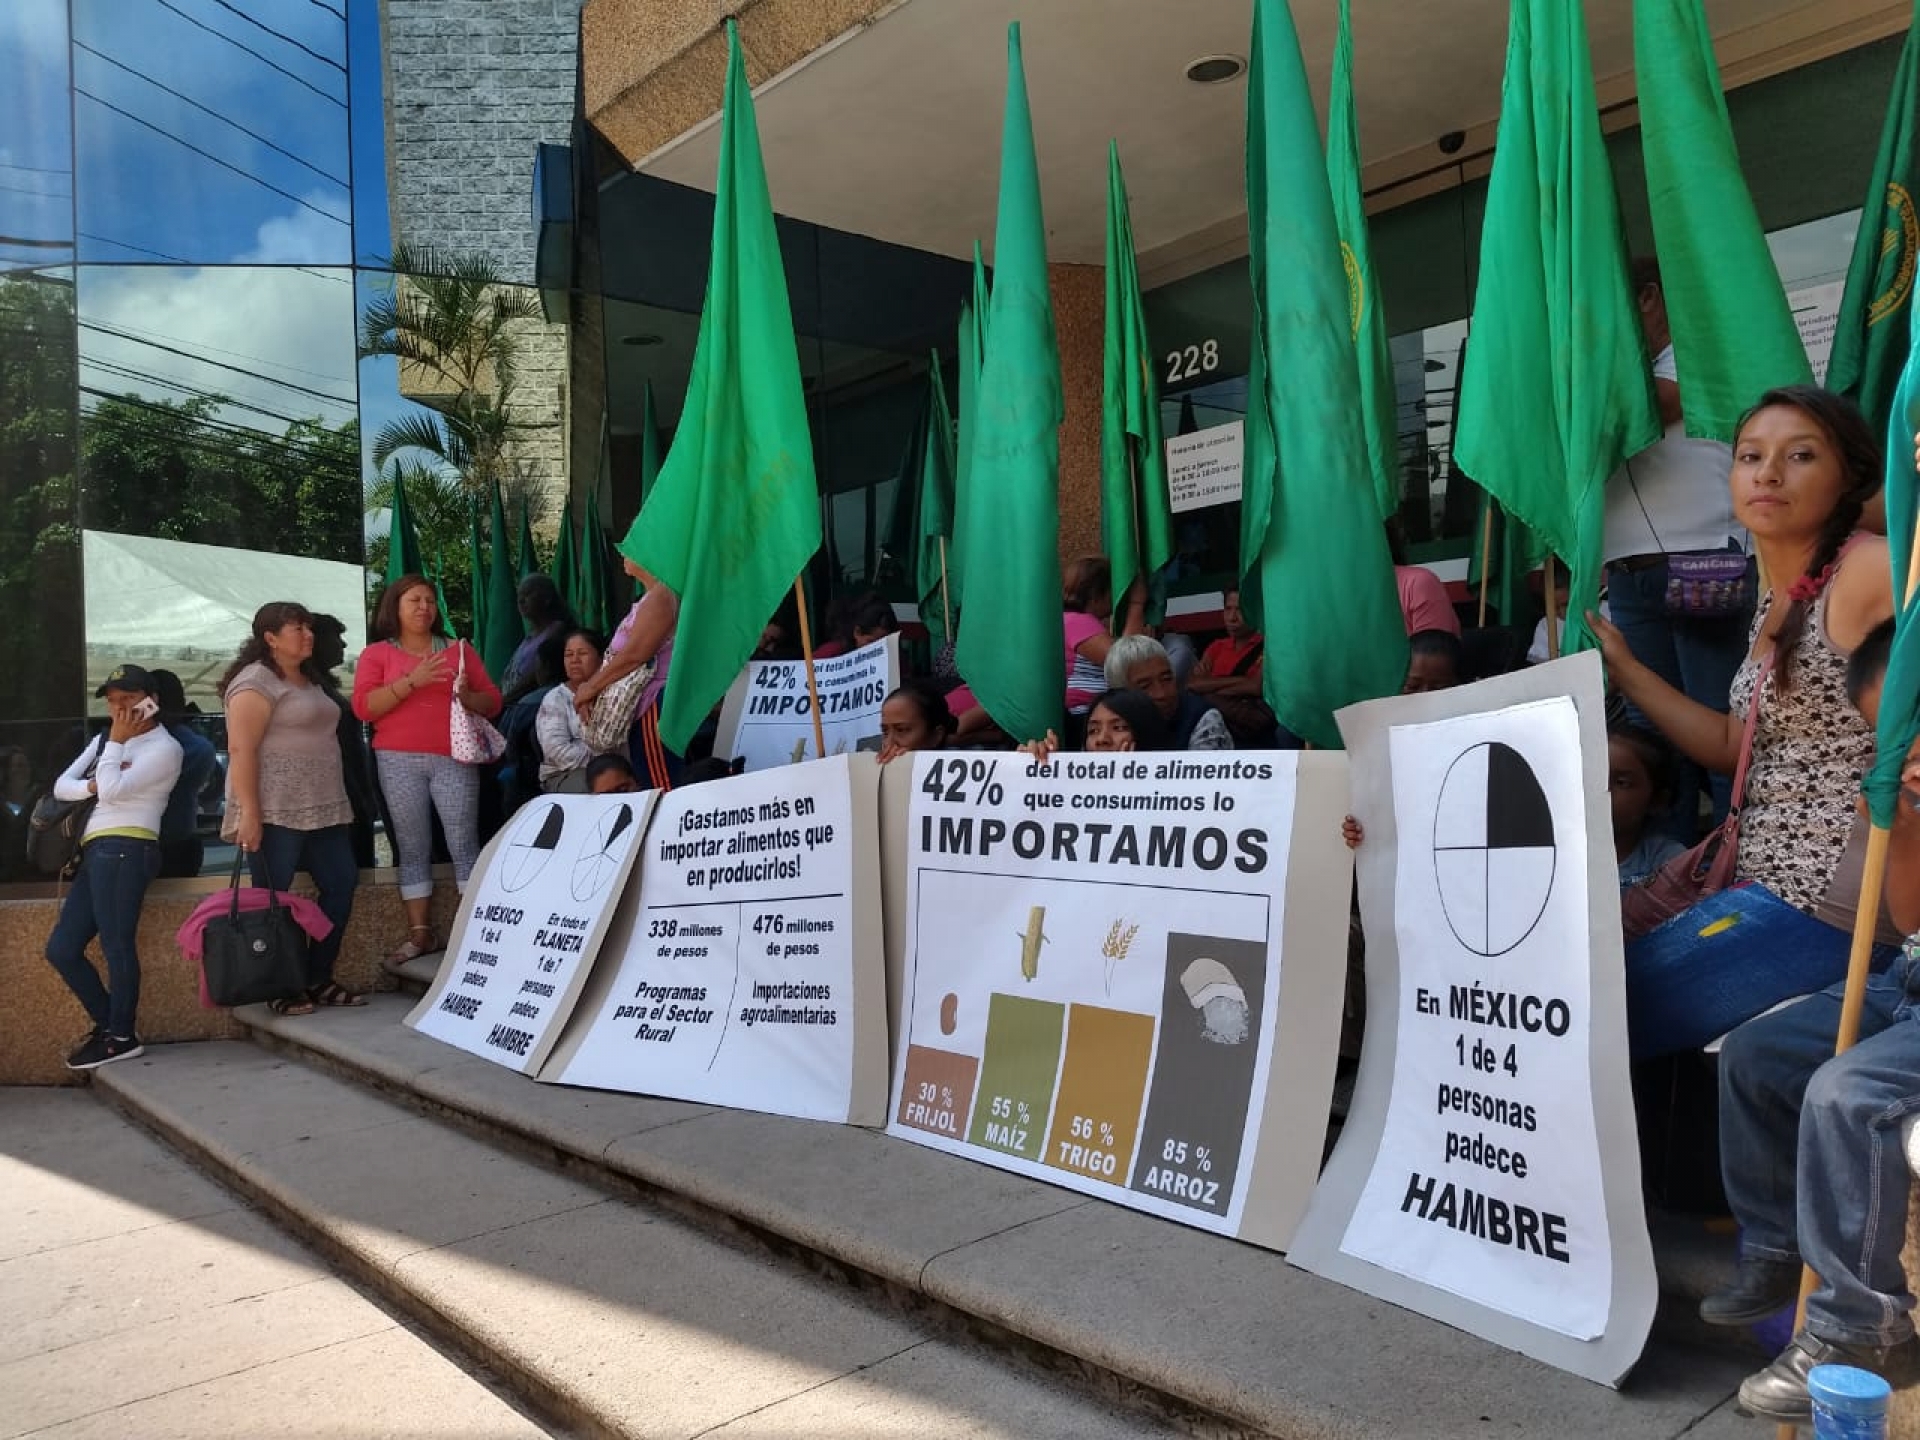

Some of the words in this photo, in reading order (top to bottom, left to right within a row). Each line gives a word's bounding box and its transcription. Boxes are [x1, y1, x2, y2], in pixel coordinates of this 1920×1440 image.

[1167, 340, 1218, 382] 228
[756, 665, 796, 690] 42%
[804, 680, 822, 690] qe
[749, 679, 884, 715] IMPORTAMOS
[922, 759, 1003, 806] 42%
[1025, 760, 1059, 778] del
[1068, 761, 1115, 779] total
[1122, 760, 1148, 779] de
[1155, 760, 1272, 780] alimentos
[1024, 794, 1064, 811] que
[1071, 792, 1204, 810] consumimos
[1214, 792, 1234, 812] lo
[679, 807, 754, 837] ¡Gastamos
[759, 796, 790, 820] más
[795, 798, 814, 816] en
[661, 837, 723, 864] importar
[727, 830, 800, 854] alimentos
[806, 825, 833, 849] que
[922, 816, 1268, 873] IMPORTAMOS
[687, 870, 704, 886] en
[710, 854, 801, 890] producirlos!
[474, 907, 483, 918] En
[547, 913, 560, 926] En
[561, 917, 579, 929] todo
[579, 918, 589, 930] el
[753, 915, 783, 934] 476
[786, 919, 834, 933] millones
[482, 927, 486, 940] 1
[486, 929, 495, 943] de
[495, 930, 501, 942] 4
[534, 930, 583, 952] PLANETA
[648, 920, 677, 938] 338
[679, 924, 722, 936] millones
[468, 951, 498, 966] personas
[657, 945, 671, 957] de
[674, 948, 708, 960] pesos
[767, 942, 780, 956] de
[784, 944, 819, 959] pesos
[538, 955, 545, 969] 1
[543, 957, 555, 972] de
[554, 958, 563, 974] 7
[462, 970, 488, 987] padece
[519, 980, 555, 998] personas
[636, 982, 706, 1003] Programas
[753, 981, 830, 1003] Importaciones
[440, 993, 482, 1020] HAMBRE
[509, 1001, 540, 1019] padece
[613, 1006, 647, 1020] para
[650, 1003, 662, 1020] el
[666, 1005, 713, 1023] Sector
[741, 1005, 836, 1026] agroalimentarias
[1416, 988, 1440, 1015] En
[1450, 981, 1570, 1036] MÉXICO
[486, 1024, 534, 1056] HAMBRE
[635, 1024, 676, 1042] Rural
[1456, 1034, 1464, 1065] 1
[1473, 1038, 1496, 1073] de
[1504, 1044, 1517, 1077] 4
[919, 1083, 936, 1102] 30
[942, 1087, 952, 1108] %
[1438, 1083, 1536, 1131] personas
[906, 1102, 956, 1132] FRIJOL
[992, 1096, 1011, 1118] 55
[1018, 1102, 1029, 1124] %
[985, 1122, 1026, 1150] MAÍZ
[1071, 1116, 1092, 1138] 56
[1101, 1122, 1113, 1146] %
[1060, 1142, 1116, 1175] TRIGO
[1163, 1140, 1188, 1164] 85
[1197, 1146, 1210, 1172] %
[1446, 1132, 1527, 1178] padece
[1144, 1167, 1218, 1204] ARROZ
[1401, 1173, 1569, 1263] HAMBRE
